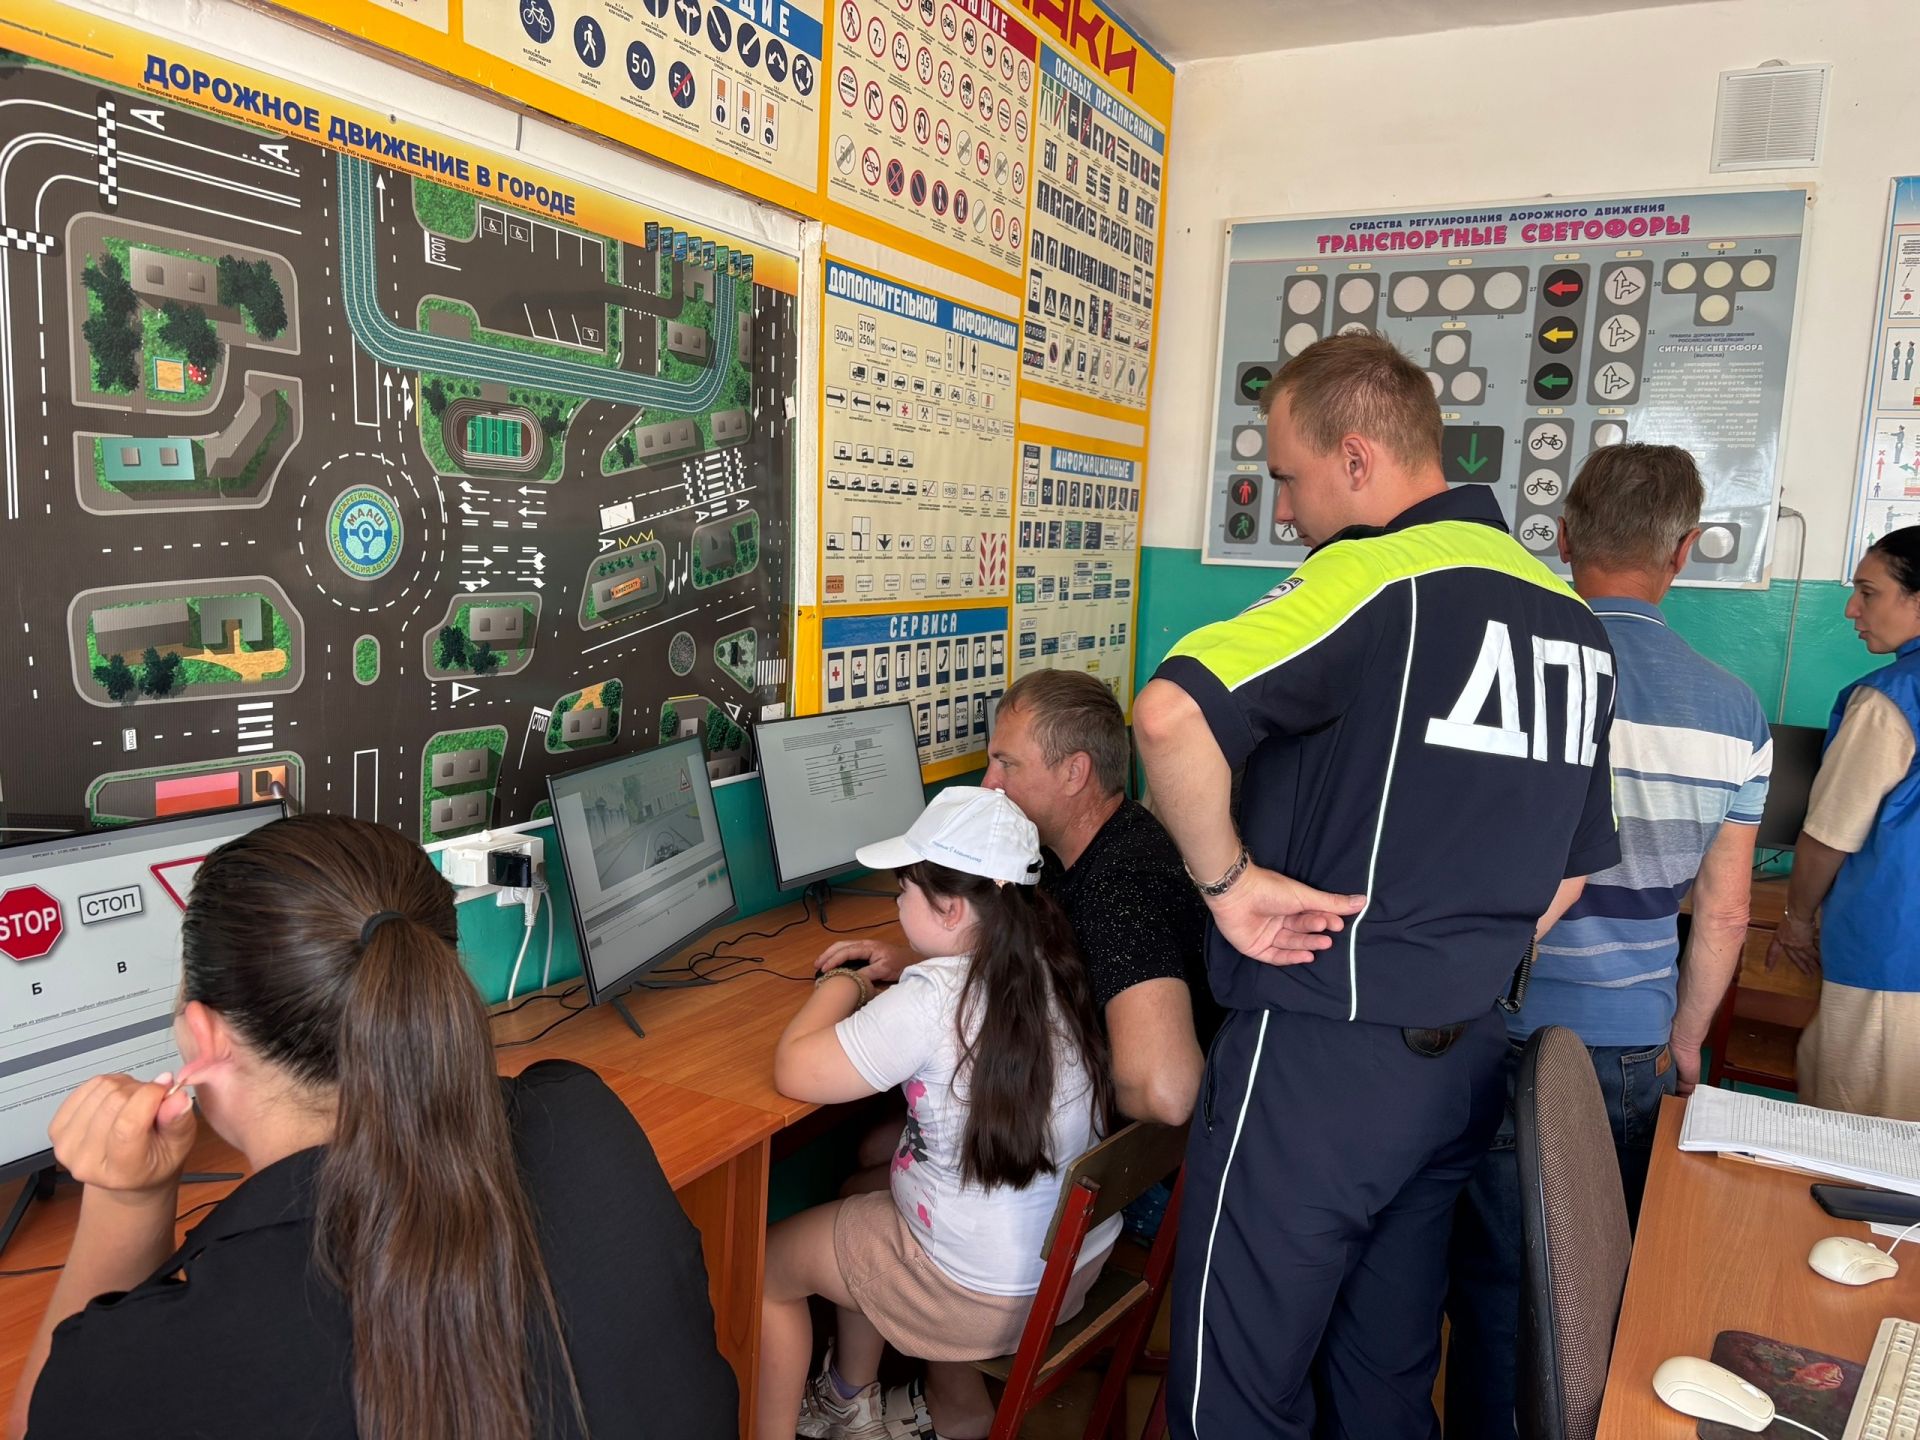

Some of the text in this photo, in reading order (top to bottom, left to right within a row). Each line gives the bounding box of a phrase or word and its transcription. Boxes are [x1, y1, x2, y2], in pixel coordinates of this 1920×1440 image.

[631, 53, 650, 78] 50
[1055, 58, 1092, 102] ОСОБЫХ
[130, 109, 165, 132] А
[144, 54, 576, 216] ДОРОЖНОЕ ДВИЖЕНИЕ В ГОРОДЕ
[259, 144, 290, 164] А
[1350, 204, 1665, 230] СРЕДСТВА РЕГУЛИРОВАНИЯ ДОРОЖНОГО ДВИЖЕНИЯ
[1316, 214, 1690, 254] ТРАНСПОРТНЫЕ СВЕТОФОРЫ
[432, 238, 446, 262] СТОП
[828, 266, 1016, 347] ДОПОЛНИТЕЛЬНОЙ ИНФОРМАЦИИ
[860, 320, 875, 334] STOP
[1658, 345, 1703, 353] СИГНАЛЫ
[1056, 450, 1130, 479] ИНФОРМАЦИОННЫЕ
[347, 508, 384, 526] МААШ
[890, 612, 958, 638] СЕРВИСА
[532, 713, 548, 733] СТОП
[86, 892, 136, 916] СТОП
[0, 907, 57, 942] STOP
[117, 961, 128, 974] В
[32, 982, 43, 996] Б
